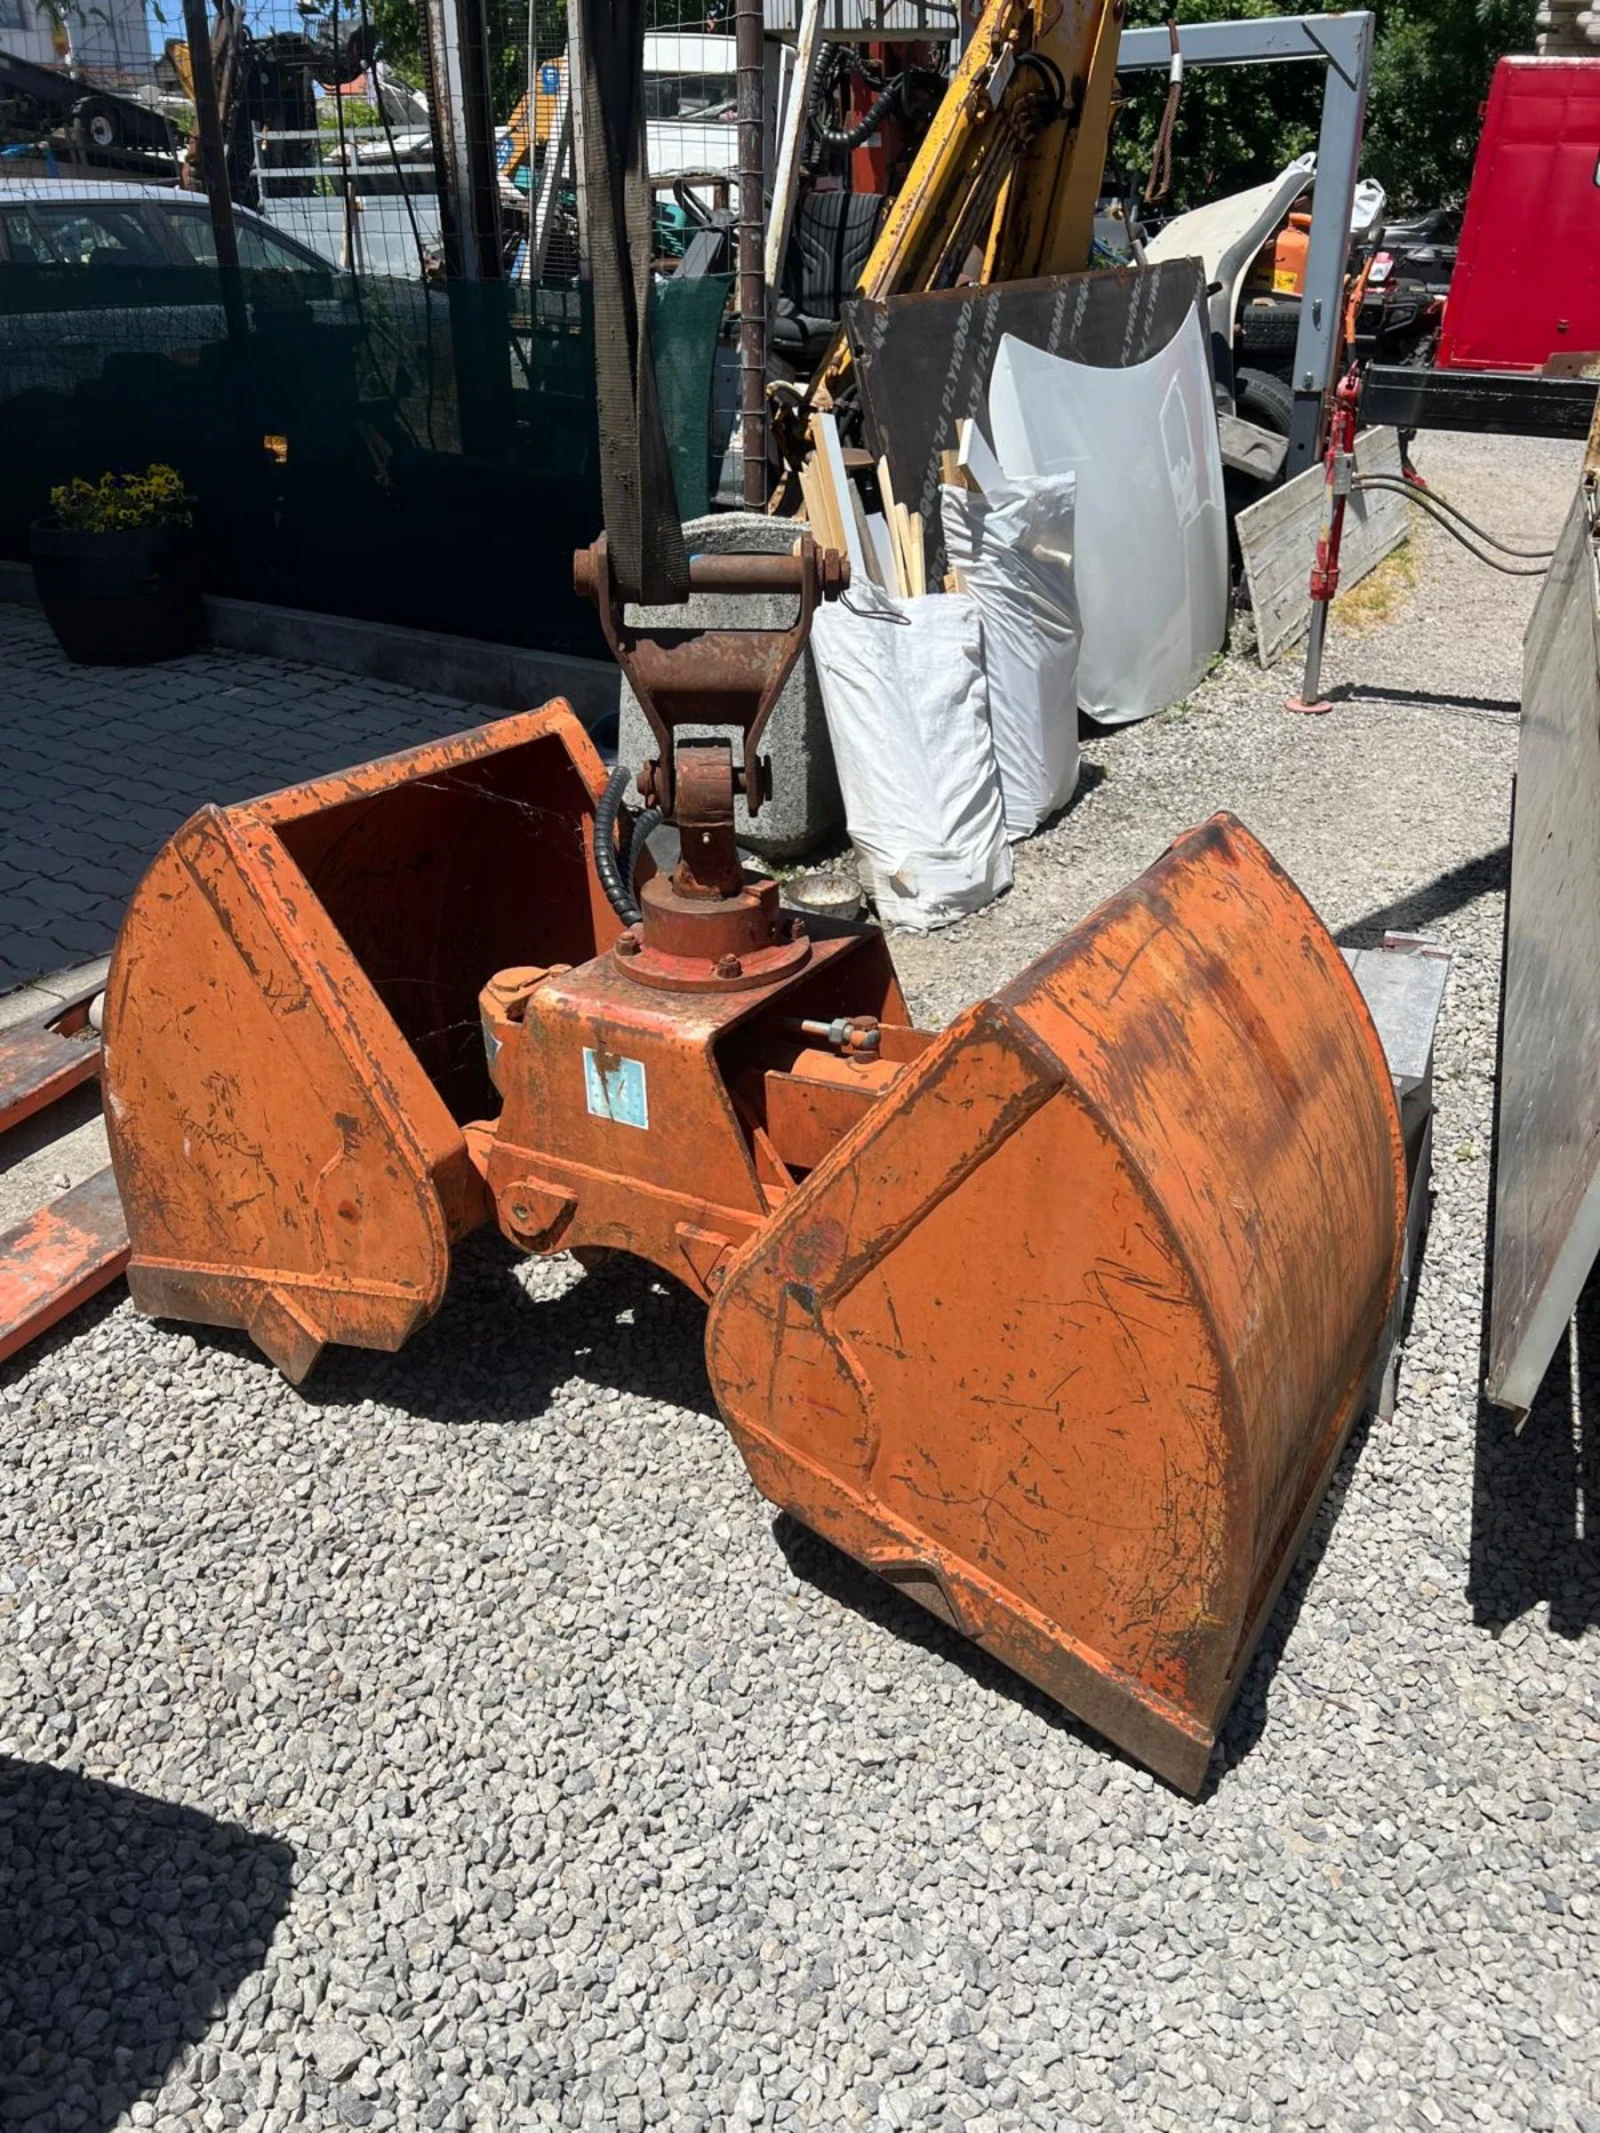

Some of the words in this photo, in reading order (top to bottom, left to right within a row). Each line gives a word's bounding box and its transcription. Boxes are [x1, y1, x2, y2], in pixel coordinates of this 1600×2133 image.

[942, 300, 973, 414] PLYWOOD
[1120, 278, 1143, 367] PLYWOOD
[919, 415, 948, 531] PLYWOO
